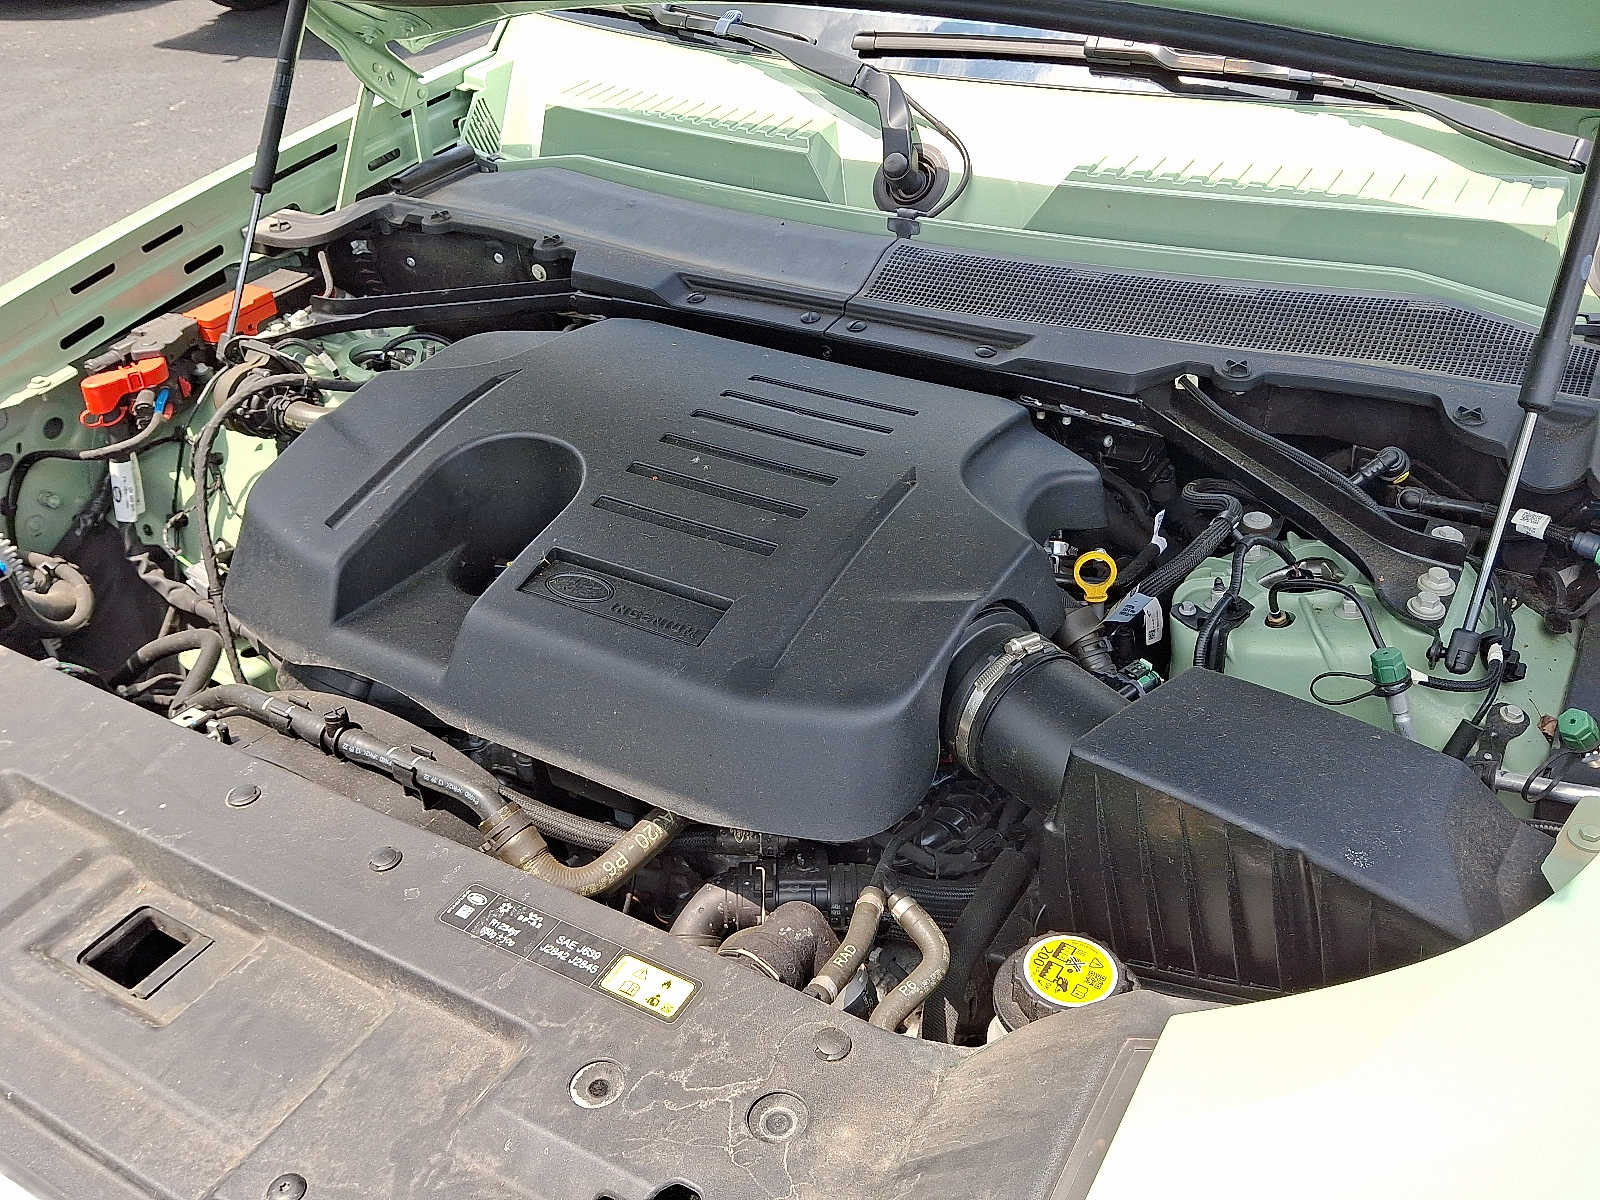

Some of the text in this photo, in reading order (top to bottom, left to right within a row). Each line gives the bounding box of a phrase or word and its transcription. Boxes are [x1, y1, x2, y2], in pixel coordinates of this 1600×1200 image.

[602, 852, 629, 877] P6
[555, 935, 577, 950] SAE
[833, 944, 857, 968] RAD
[1033, 945, 1054, 967] 200
